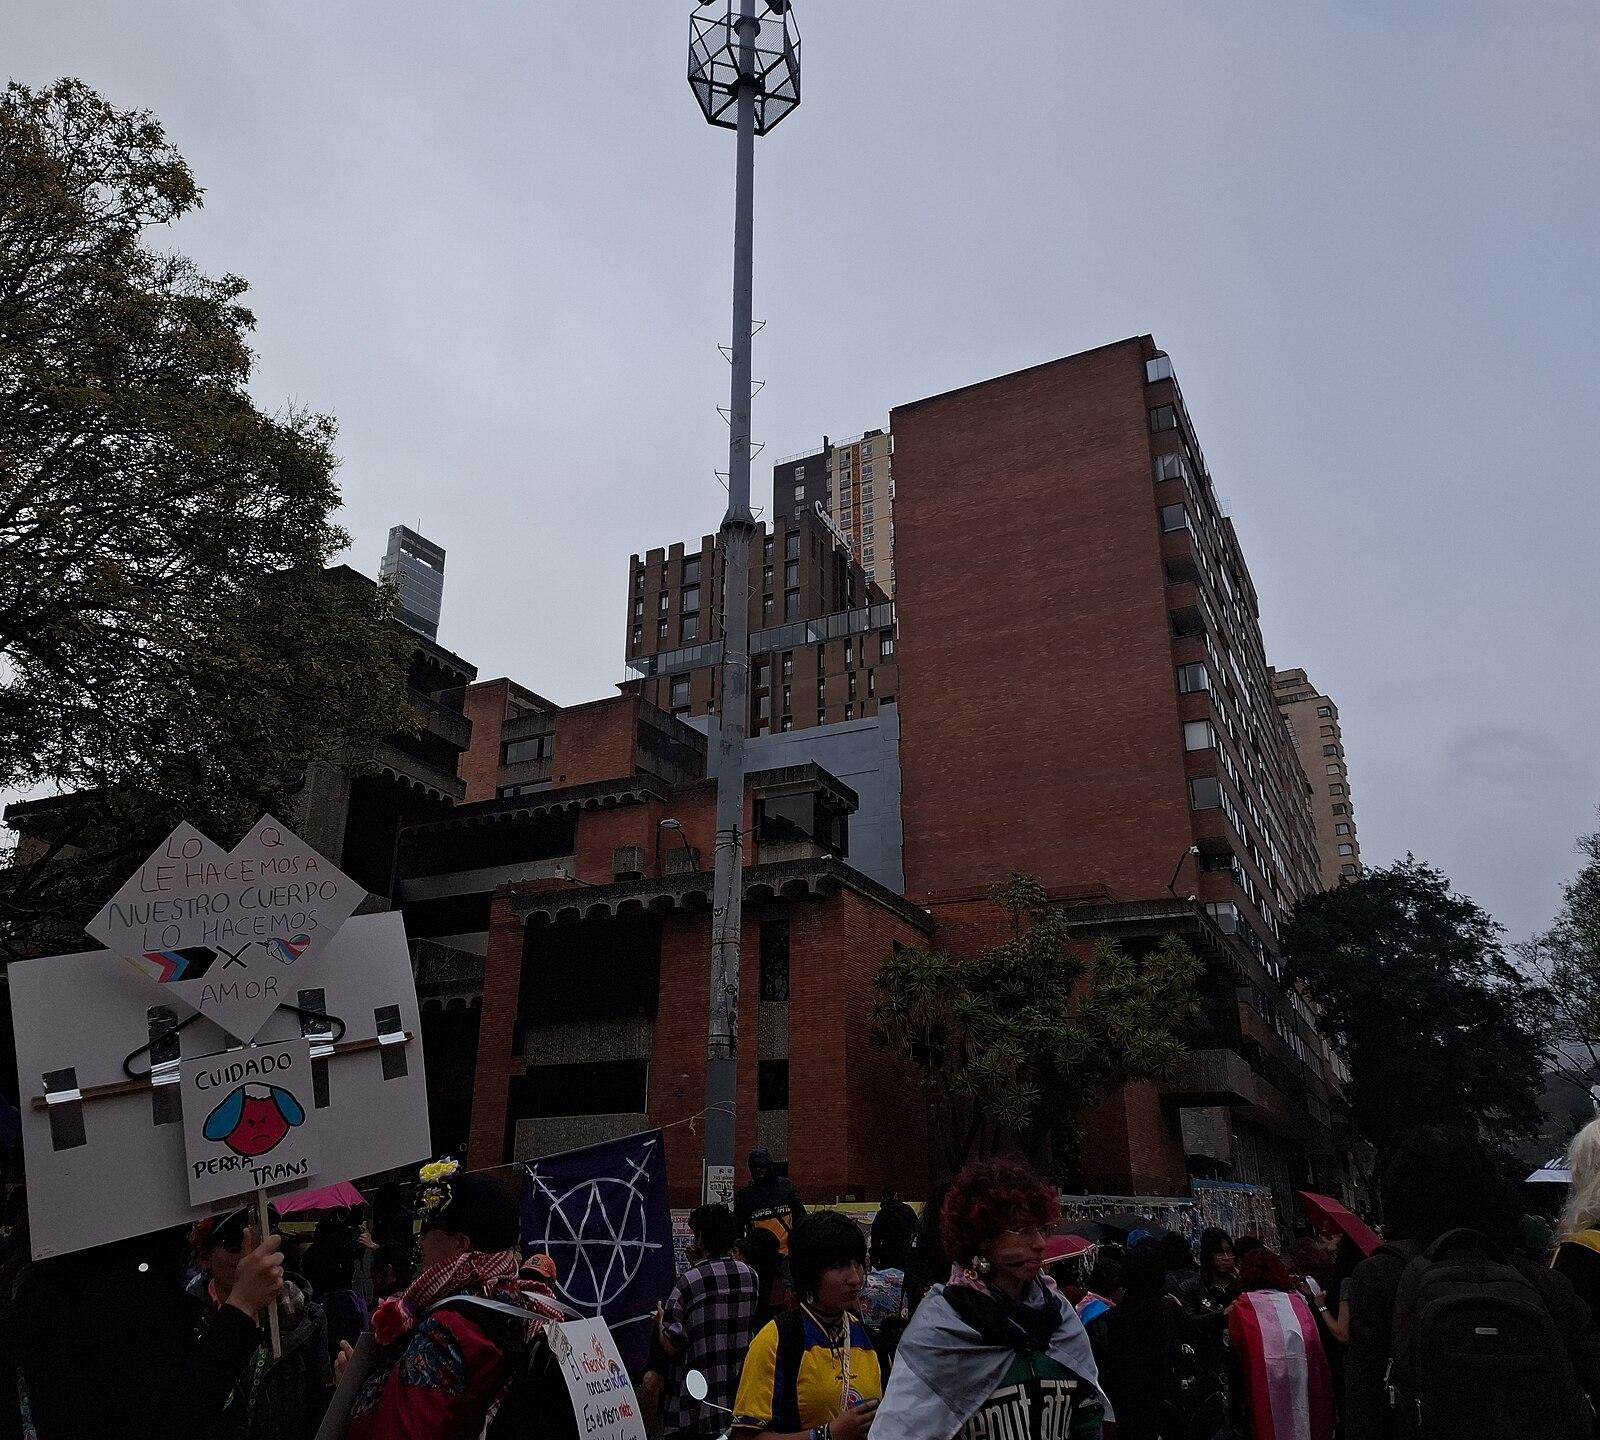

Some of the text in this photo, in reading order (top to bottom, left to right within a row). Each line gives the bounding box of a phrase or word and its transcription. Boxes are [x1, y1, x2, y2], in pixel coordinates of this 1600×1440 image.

[166, 827, 284, 859] LO Q
[141, 856, 319, 892] LE HACEMOS A
[108, 880, 338, 930] NUESTRO CUERPO
[143, 910, 318, 951] LO HACEMOS
[215, 941, 252, 970] X
[200, 976, 278, 1009] AMOR
[195, 1053, 292, 1090] CUIDADO
[192, 1155, 254, 1179] PERRA
[249, 1158, 308, 1187] TRANS
